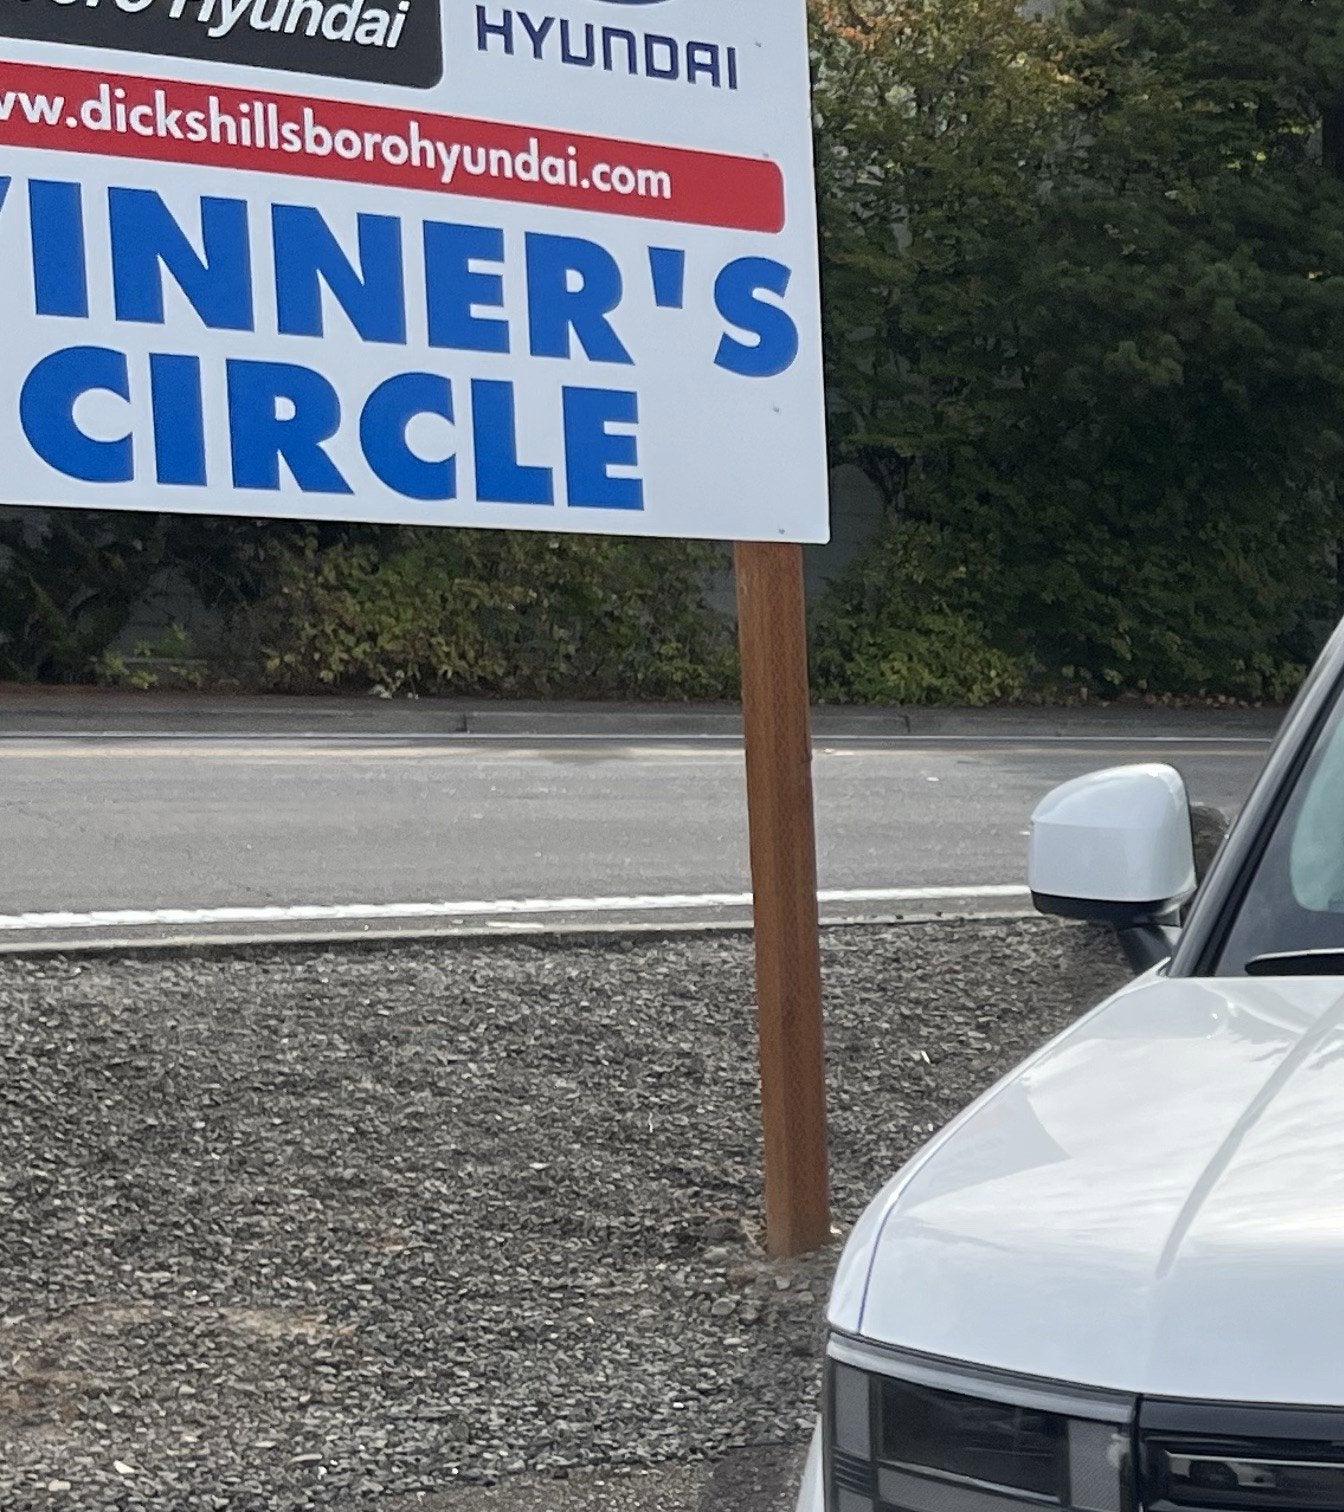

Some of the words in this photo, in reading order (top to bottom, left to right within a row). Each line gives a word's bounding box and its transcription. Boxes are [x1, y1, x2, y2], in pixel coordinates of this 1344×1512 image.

[475, 4, 738, 90] HYUNDAI
[0, 175, 800, 378] INNER'S
[19, 344, 645, 512] CIRCLE
